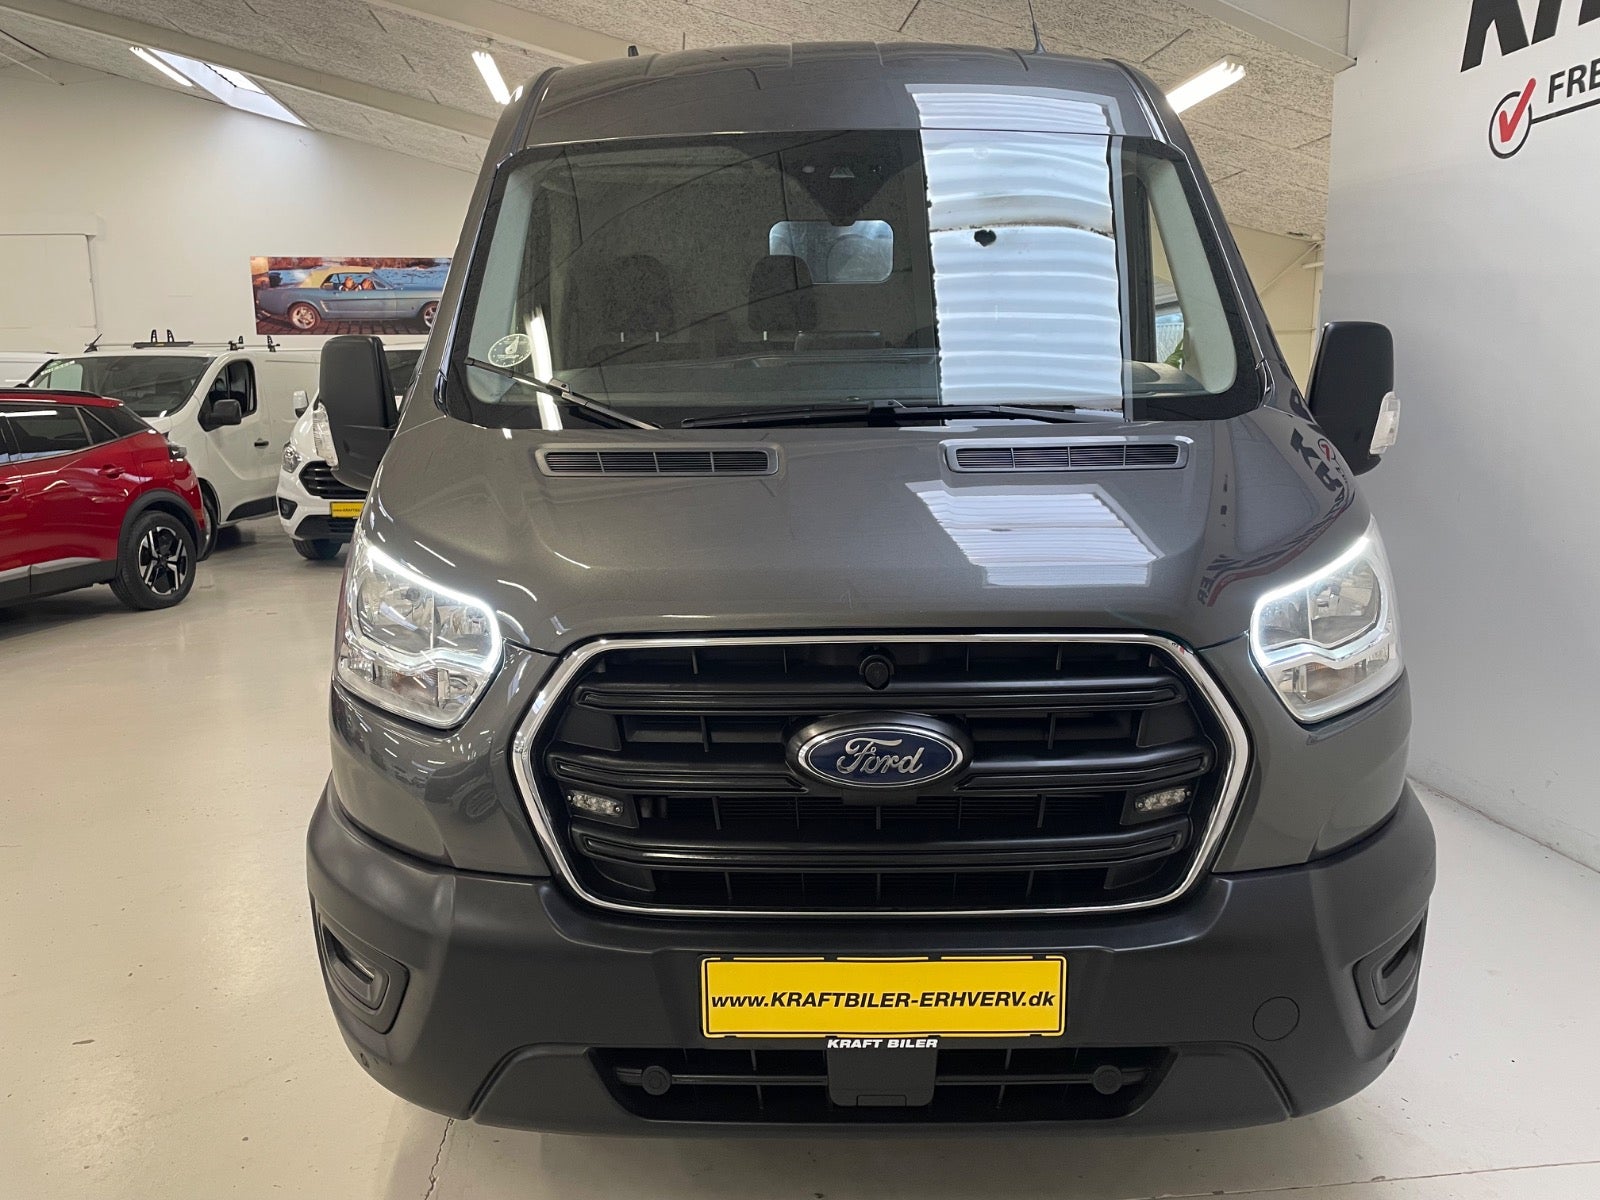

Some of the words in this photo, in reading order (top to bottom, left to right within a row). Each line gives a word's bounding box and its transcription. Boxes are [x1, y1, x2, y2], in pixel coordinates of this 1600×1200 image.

[836, 737, 925, 774] Ford
[711, 991, 1056, 1008] www.KRAFTBILER-ERHVERV.dk
[827, 1039, 883, 1049] KRAFT
[887, 1038, 939, 1048] BILER
